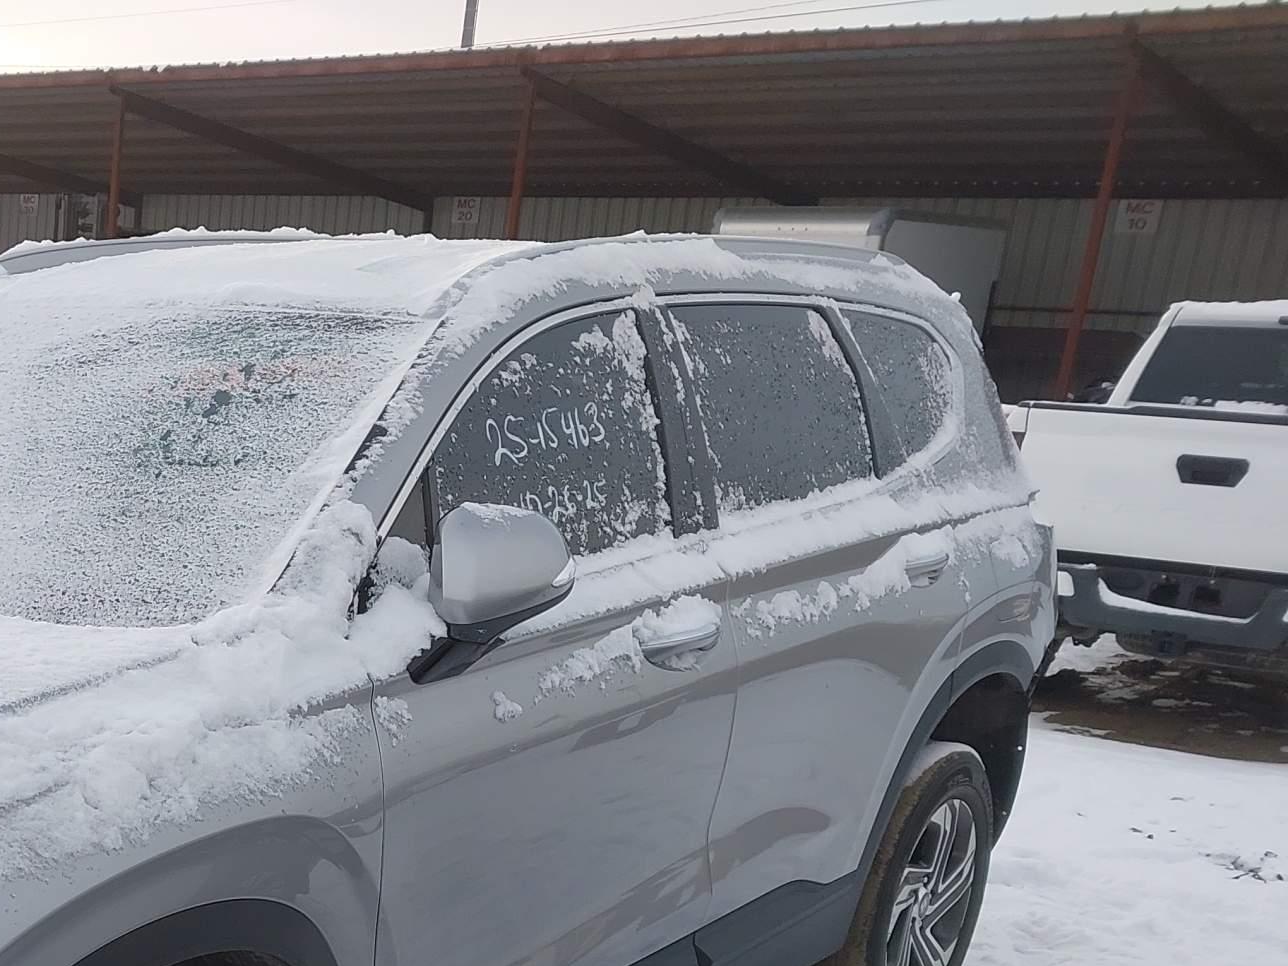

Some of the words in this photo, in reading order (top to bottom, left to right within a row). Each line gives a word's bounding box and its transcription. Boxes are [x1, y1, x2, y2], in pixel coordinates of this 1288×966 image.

[457, 198, 476, 209] MC
[1126, 201, 1155, 214] MC
[457, 211, 473, 221] 20
[1128, 217, 1148, 230] 10
